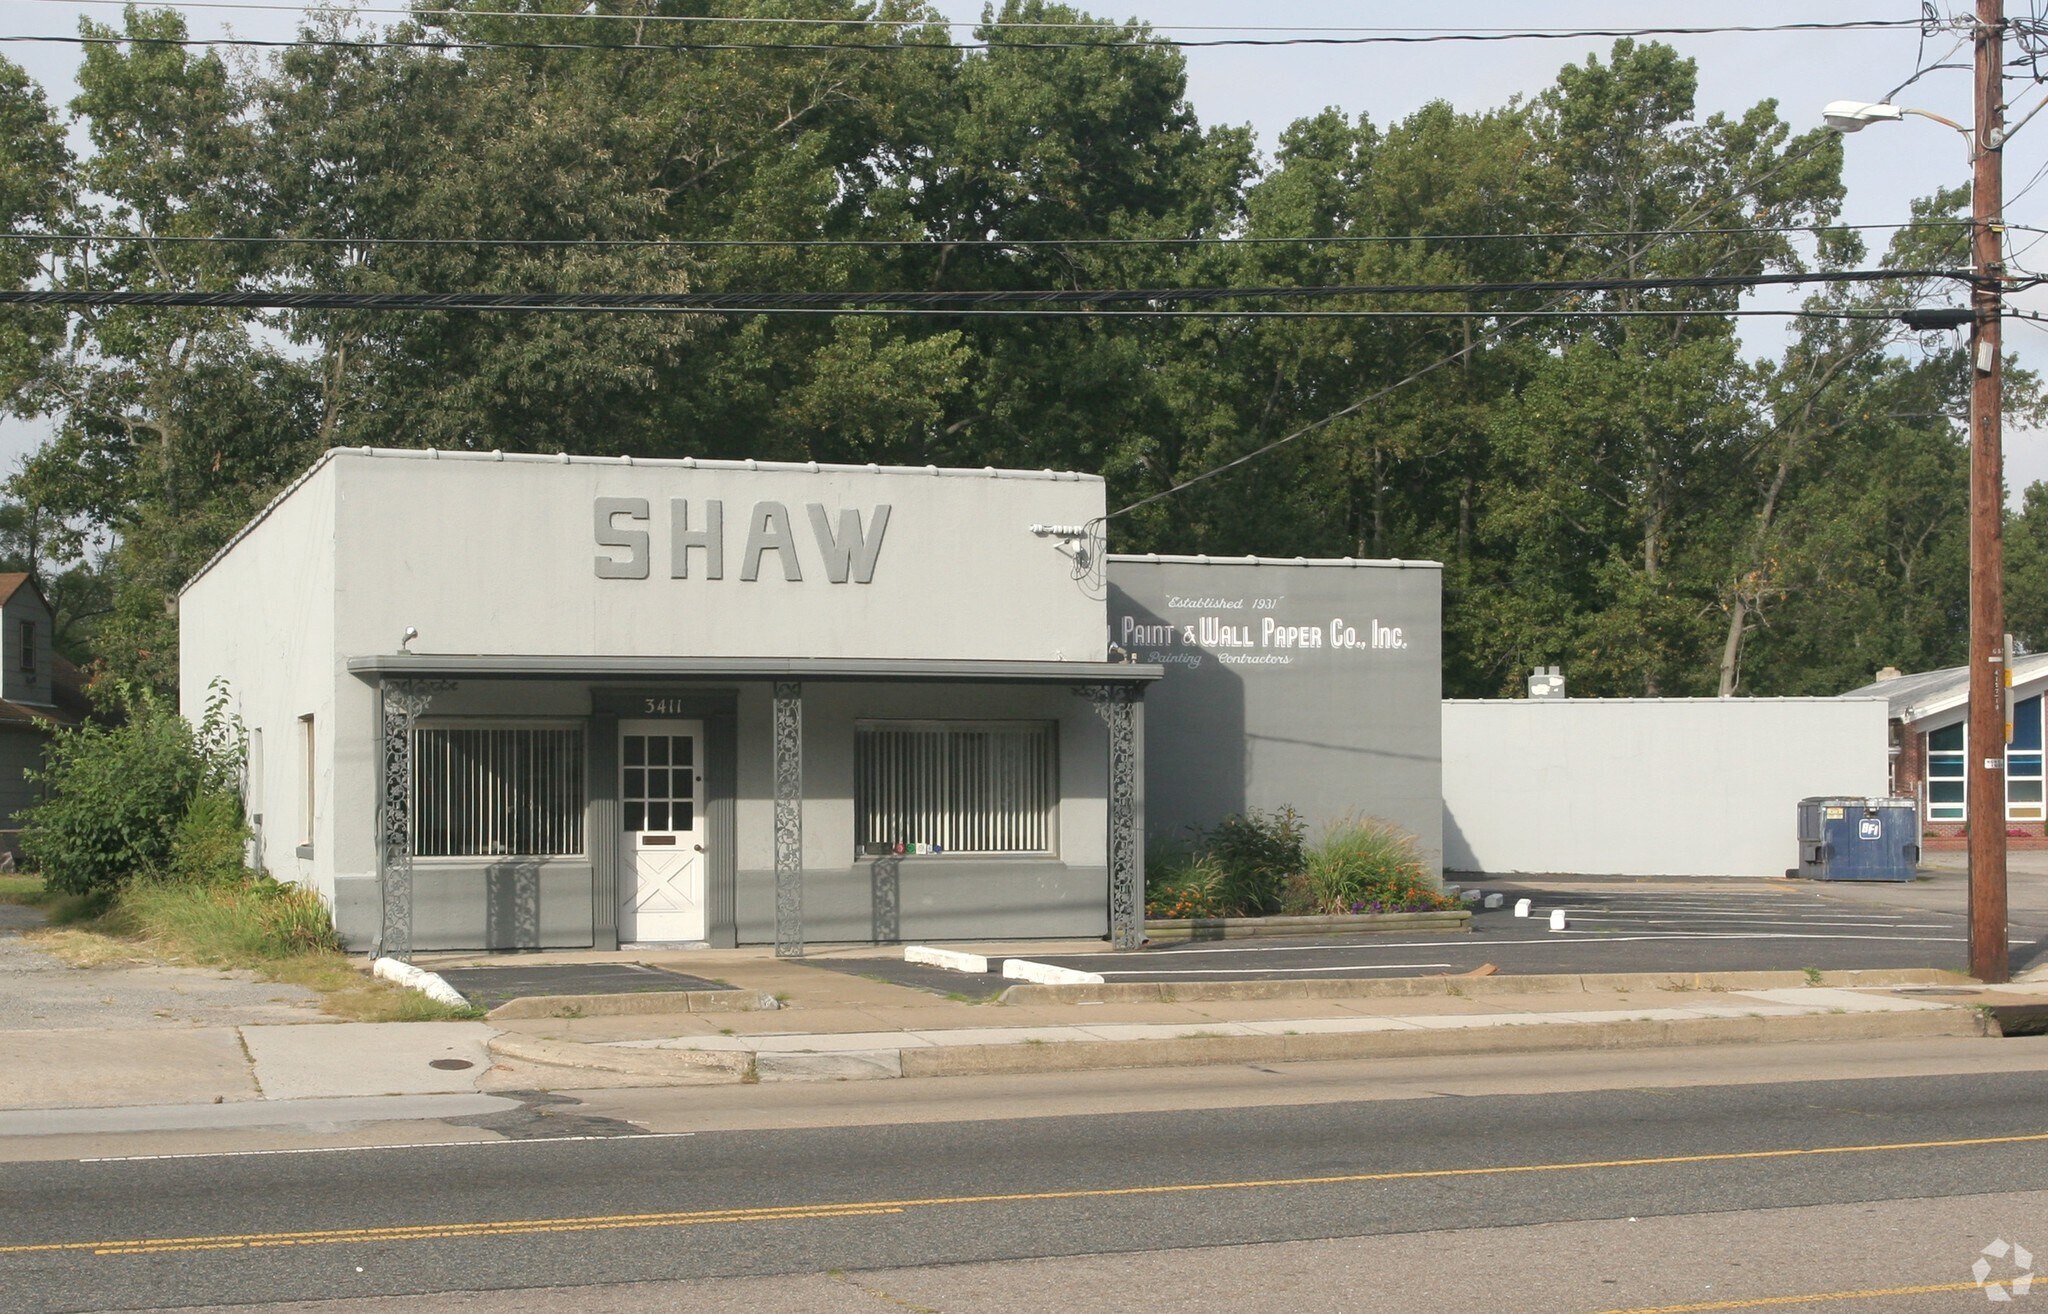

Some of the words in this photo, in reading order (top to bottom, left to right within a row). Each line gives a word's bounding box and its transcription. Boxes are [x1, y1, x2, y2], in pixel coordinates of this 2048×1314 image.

[594, 497, 892, 583] SHAW
[1147, 651, 1202, 669] Painting
[1217, 652, 1294, 664] Contractors
[644, 698, 682, 714] 3411
[1861, 822, 1879, 836] BFI
